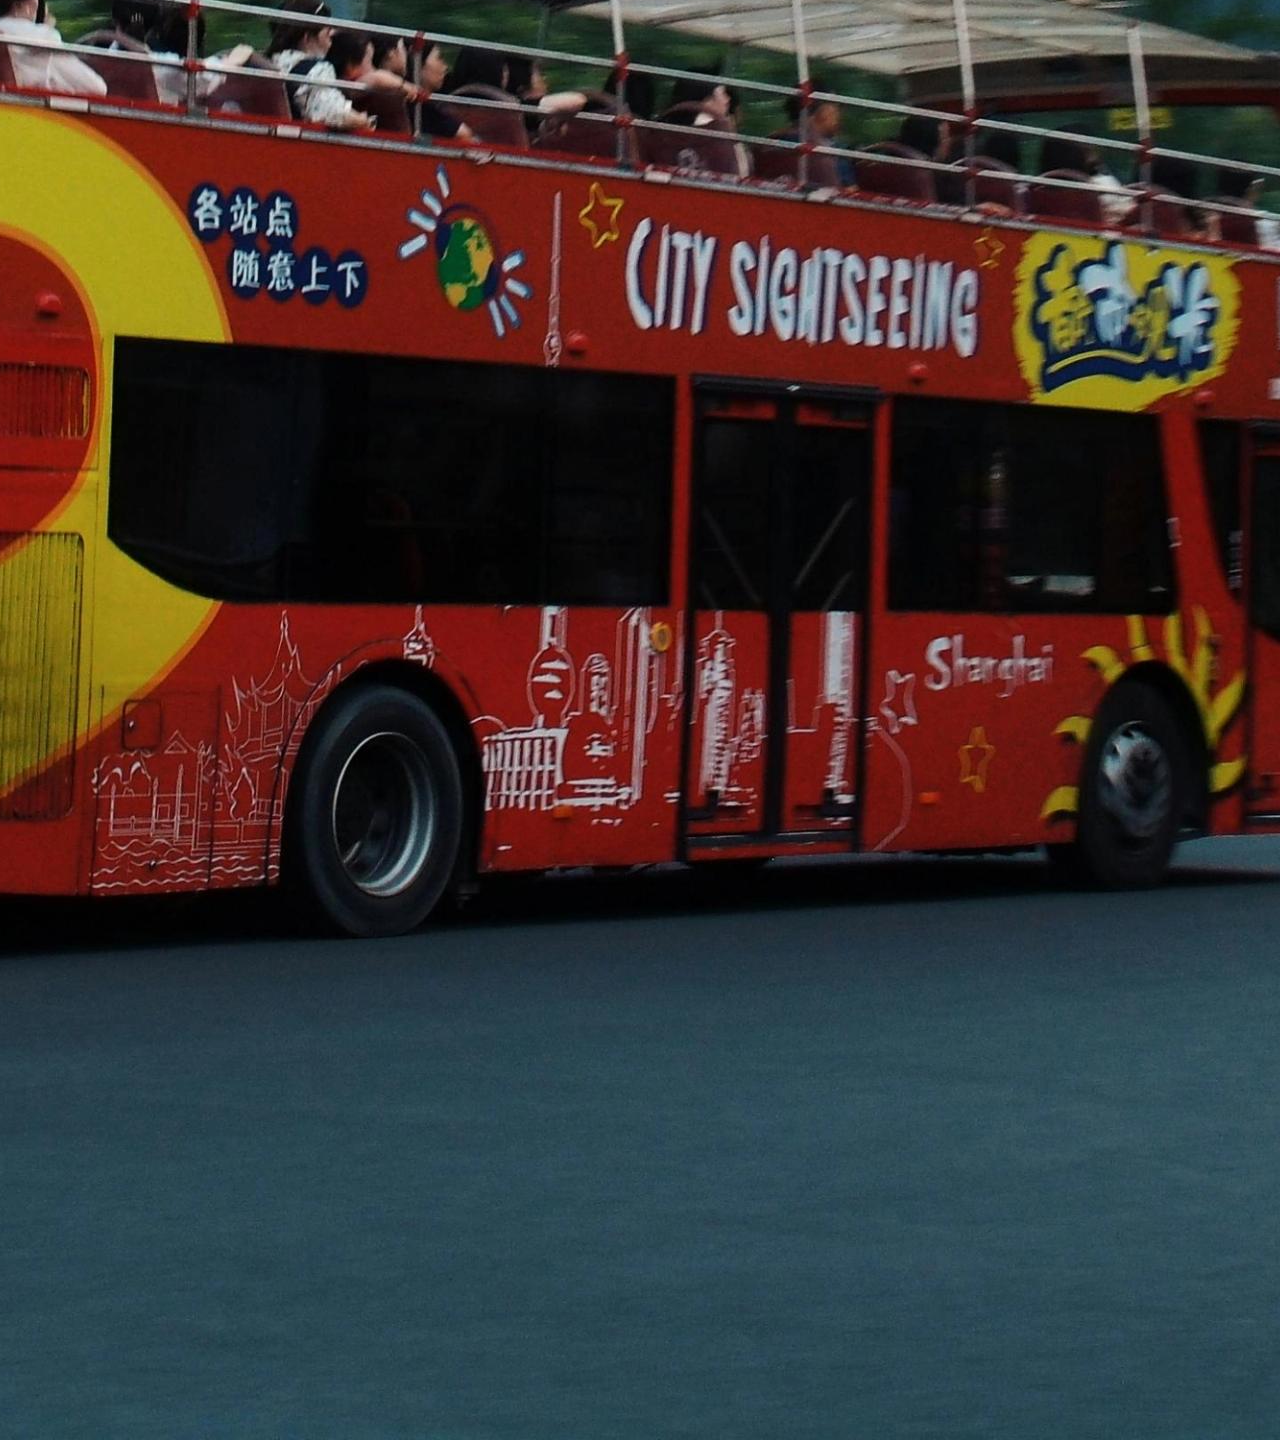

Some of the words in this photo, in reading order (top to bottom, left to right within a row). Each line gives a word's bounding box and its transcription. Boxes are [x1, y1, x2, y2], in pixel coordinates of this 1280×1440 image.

[192, 188, 294, 240] 各站点
[230, 249, 364, 299] 随意上下
[626, 216, 718, 335] CITY
[728, 234, 980, 359] SIGHTSEEING
[924, 633, 1055, 698] Shanghai
